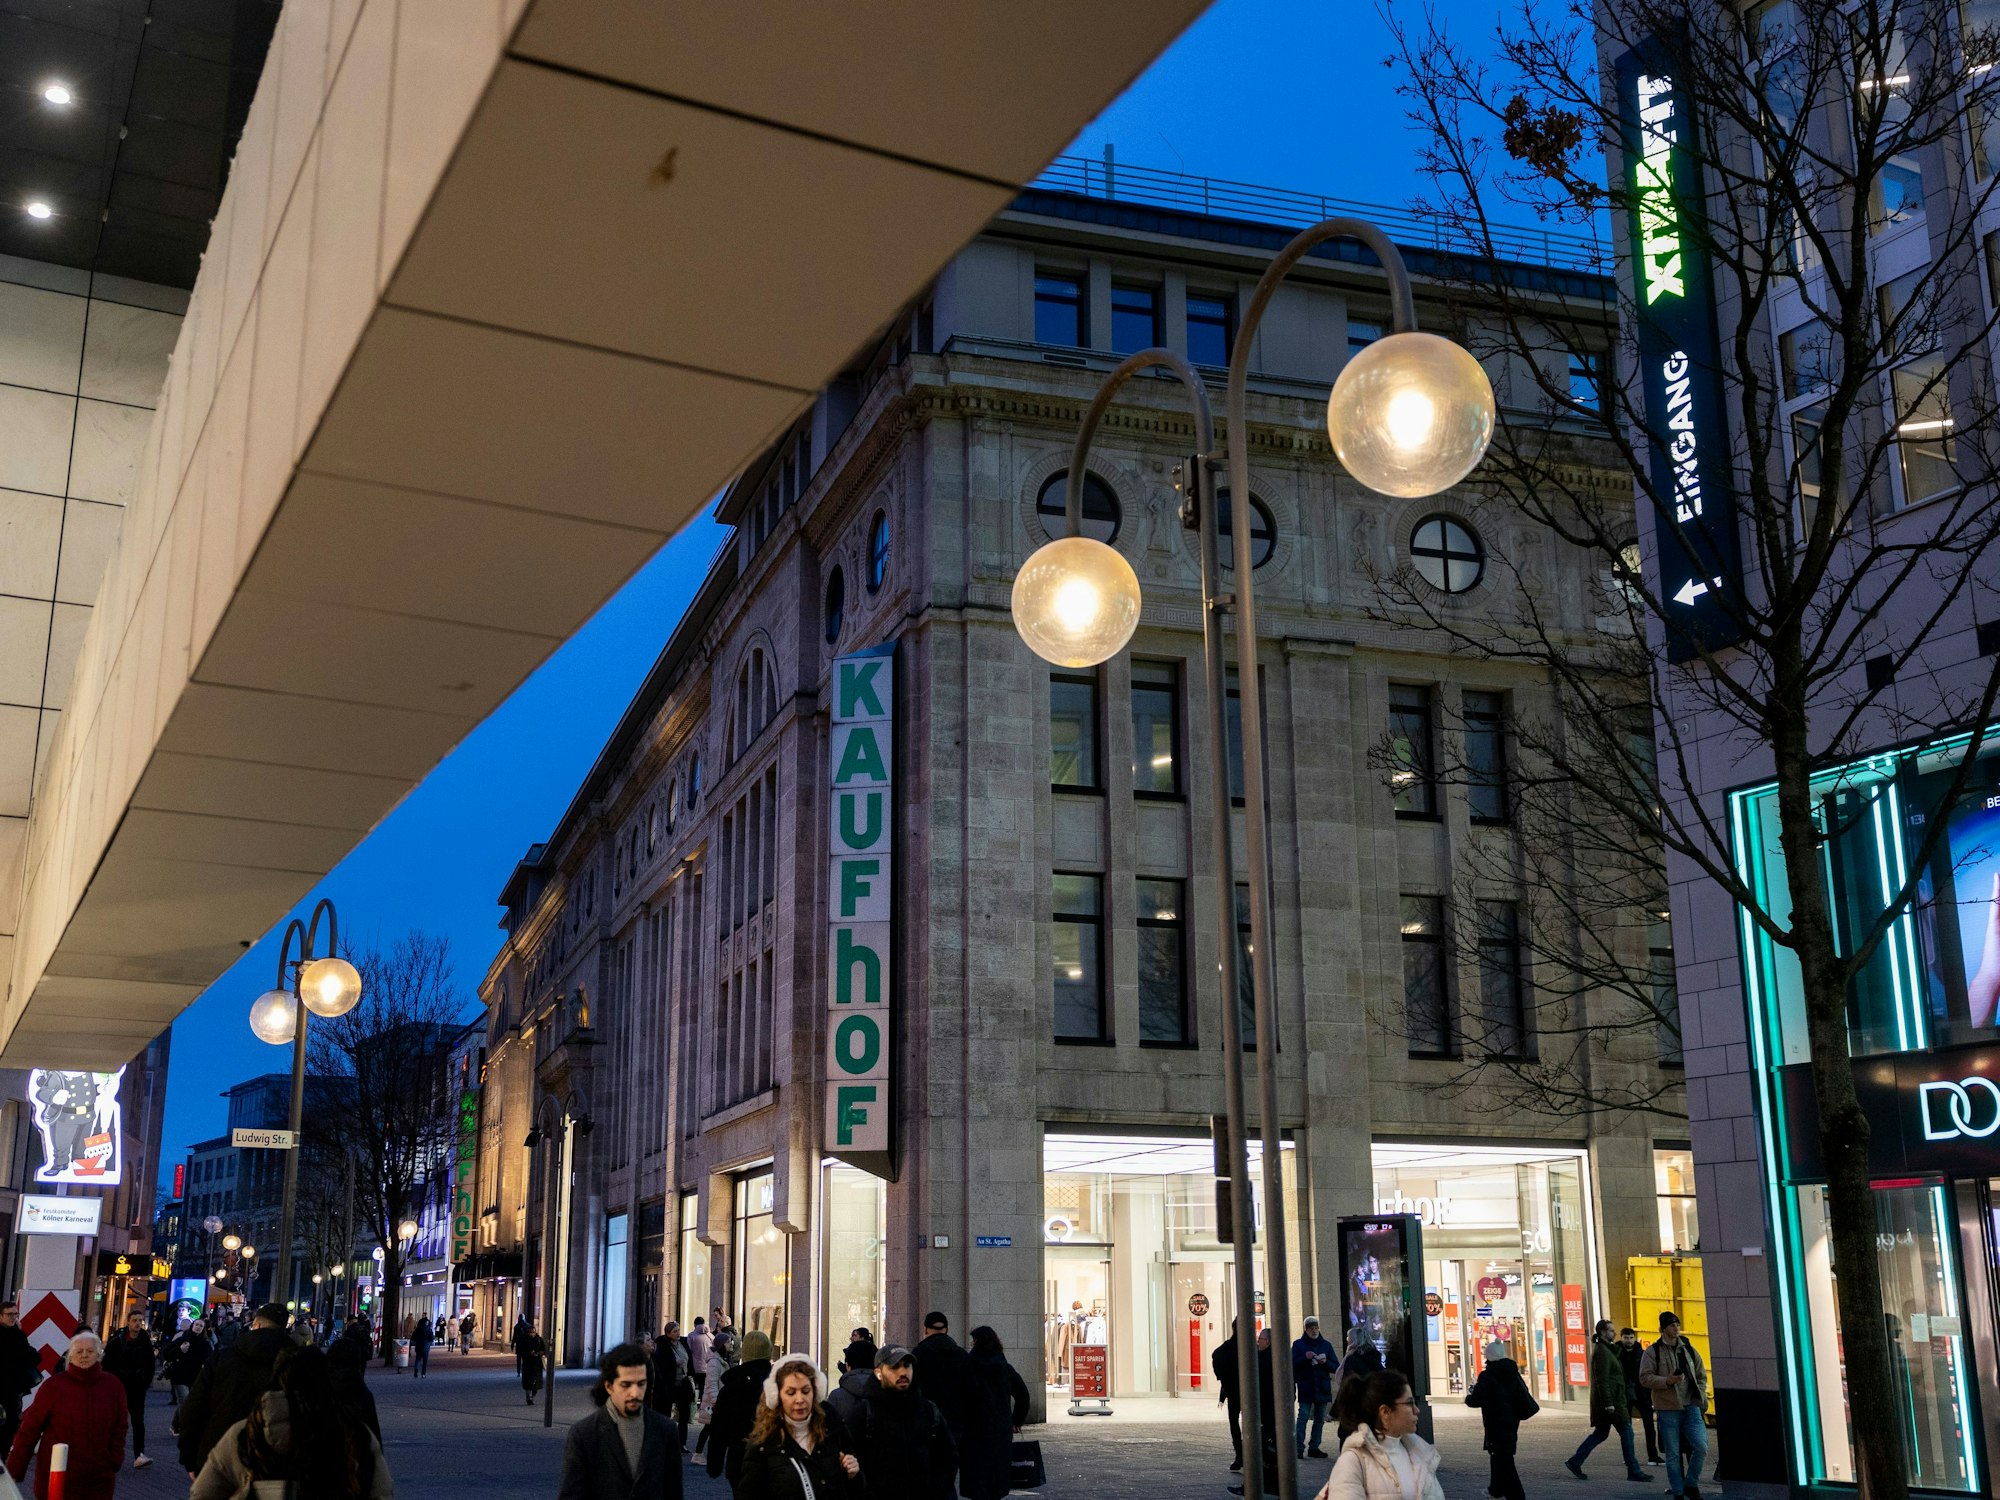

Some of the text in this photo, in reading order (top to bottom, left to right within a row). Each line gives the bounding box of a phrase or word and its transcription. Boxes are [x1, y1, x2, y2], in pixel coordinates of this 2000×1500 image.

[1663, 350, 1703, 523] EINGANG
[236, 1132, 288, 1146] Ludwig Str.
[1483, 1287, 1502, 1295] ZEIGE
[1190, 1303, 1209, 1312] 70%
[1565, 1301, 1582, 1310] SALE
[1568, 1344, 1585, 1354] SALE
